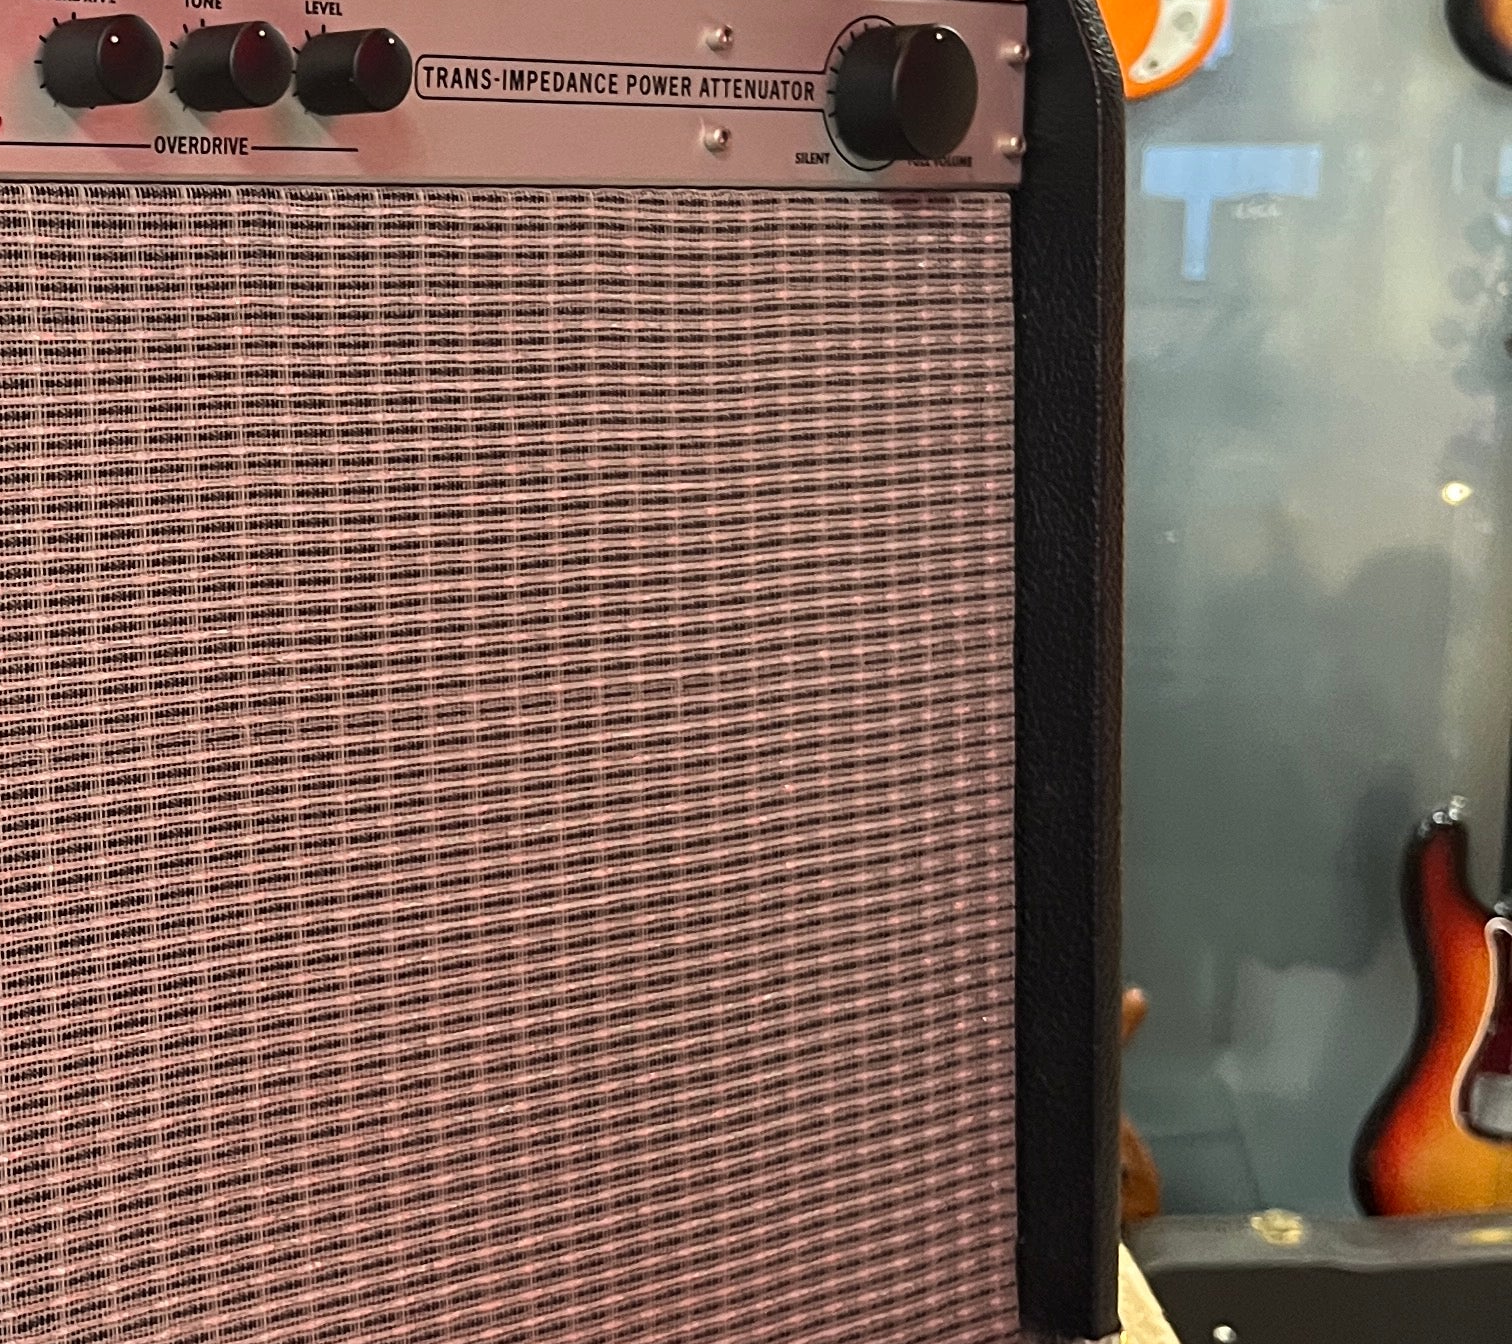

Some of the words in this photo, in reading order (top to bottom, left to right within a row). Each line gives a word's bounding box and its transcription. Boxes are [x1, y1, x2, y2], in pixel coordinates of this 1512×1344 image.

[304, 0, 343, 17] LEVEL
[422, 66, 619, 95] TRANS-IMPEDANCE
[626, 74, 691, 97] POWER
[699, 76, 816, 102] ATTENUATOR
[154, 135, 250, 156] OVERDRIVE
[795, 152, 830, 165] SILENT
